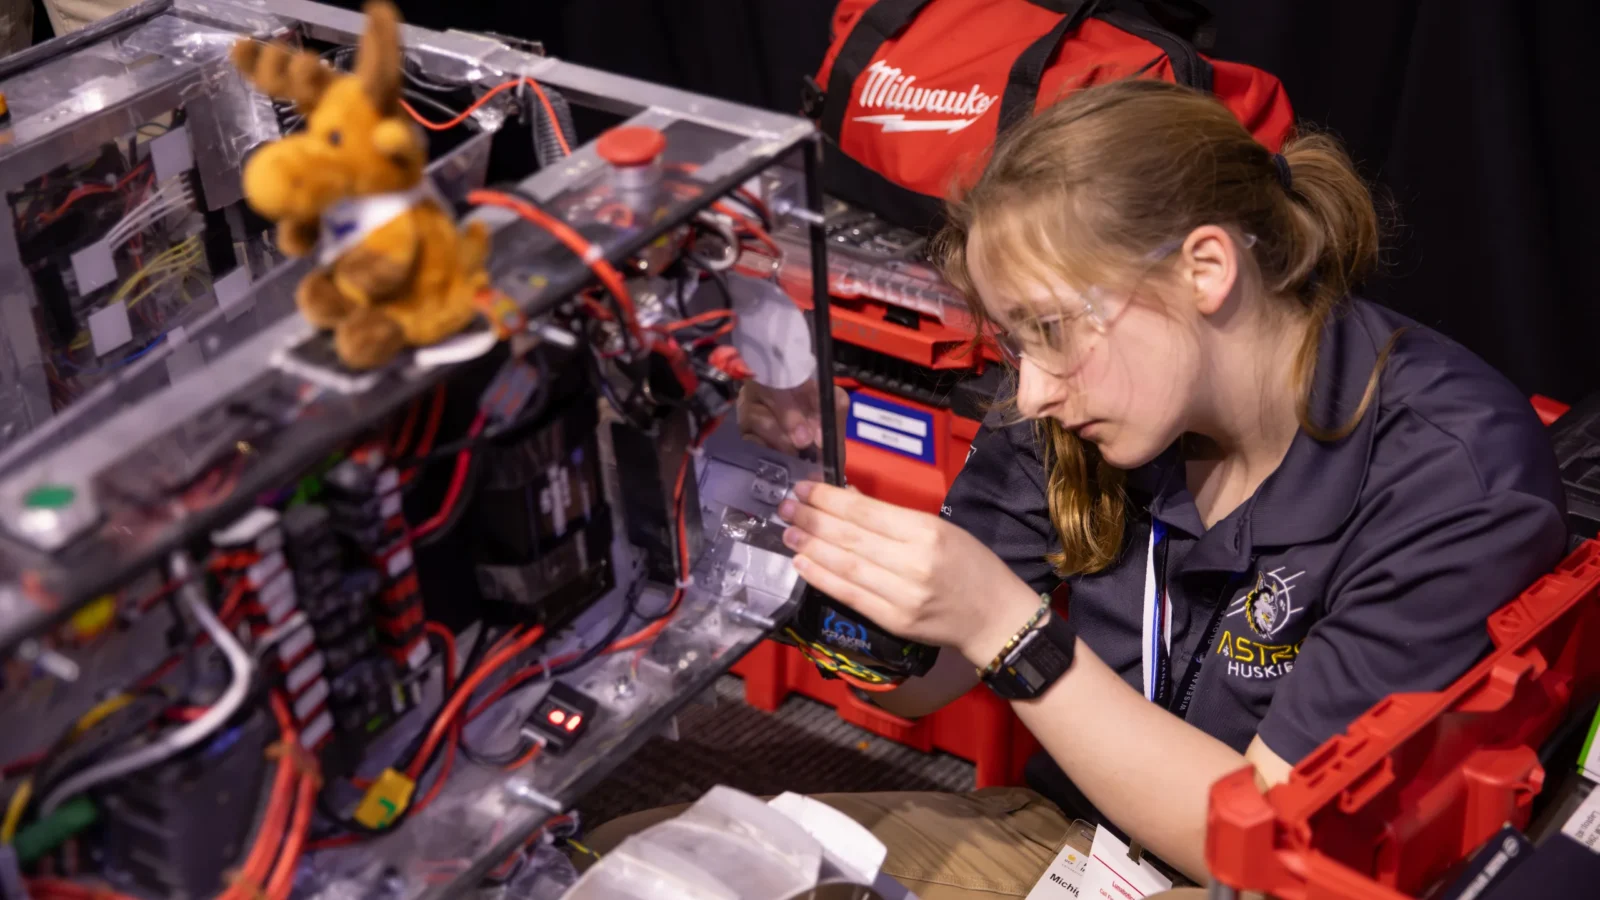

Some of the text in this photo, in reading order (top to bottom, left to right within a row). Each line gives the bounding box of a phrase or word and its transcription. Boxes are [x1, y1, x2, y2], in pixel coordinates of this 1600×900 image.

[859, 59, 998, 115] Milwauke
[821, 628, 872, 650] KRAKEN
[1227, 660, 1296, 679] HUSKIE
[1179, 671, 1200, 710] WISEMAN
[1049, 873, 1080, 898] Michig
